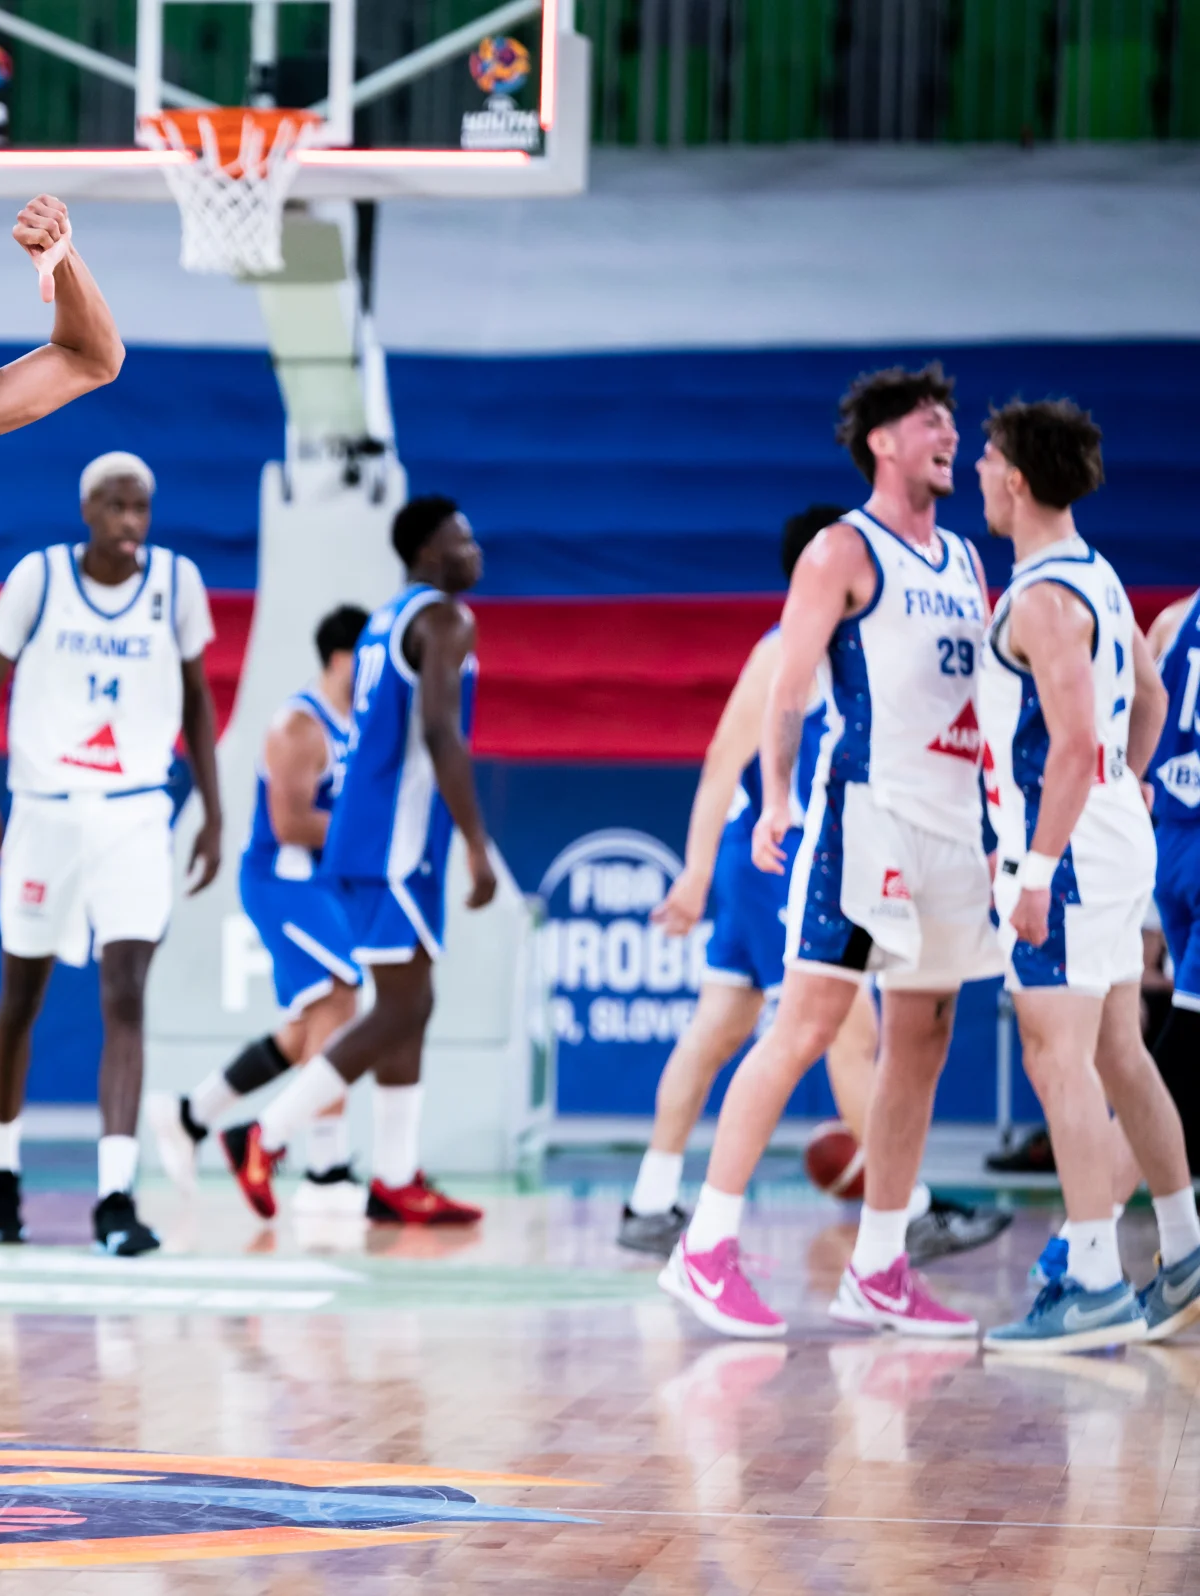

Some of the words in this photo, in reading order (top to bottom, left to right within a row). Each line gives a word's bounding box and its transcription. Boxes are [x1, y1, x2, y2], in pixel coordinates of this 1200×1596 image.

[56, 630, 150, 659] FRANCE
[937, 636, 974, 676] 29
[88, 673, 120, 703] 14
[570, 860, 666, 914] FIBA
